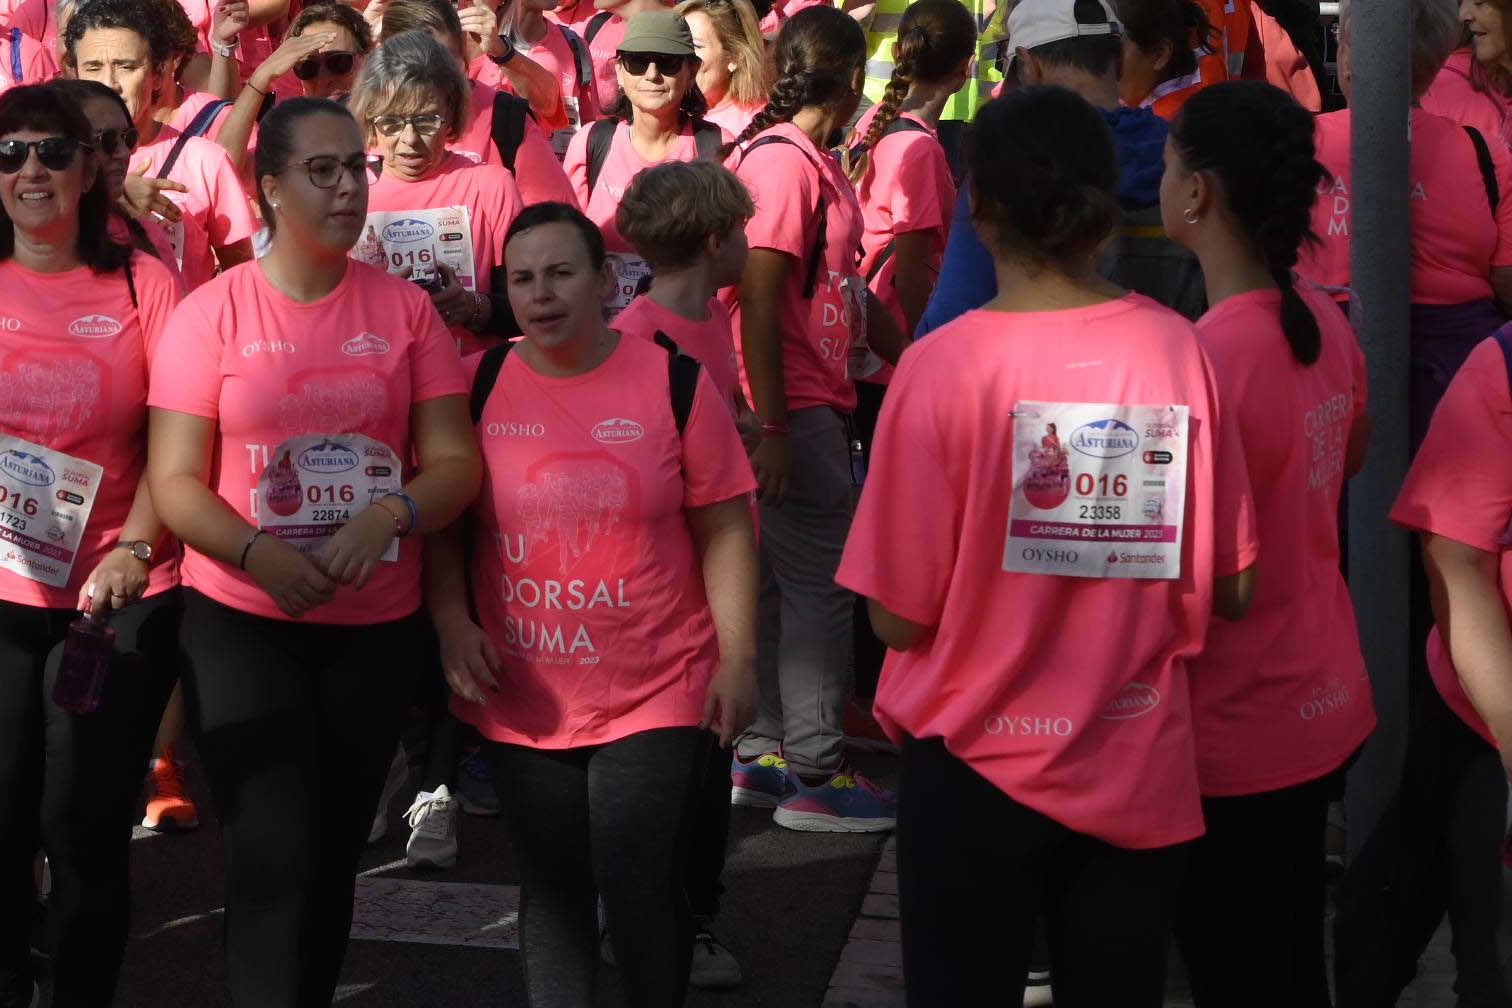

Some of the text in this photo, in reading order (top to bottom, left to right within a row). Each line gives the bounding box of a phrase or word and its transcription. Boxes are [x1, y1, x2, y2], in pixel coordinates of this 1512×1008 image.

[391, 249, 431, 267] 016
[242, 339, 296, 358] OYSHO
[488, 422, 545, 437] OYSHO
[1075, 433, 1134, 449] ASTURIANA
[302, 455, 355, 466] ASTURIANA
[1, 456, 50, 484] ASTURIANA
[1076, 472, 1128, 497] 016
[306, 484, 355, 504] 016
[312, 510, 350, 522] 22874
[1079, 505, 1121, 520] 23358
[2, 530, 13, 539] LA
[1030, 526, 1080, 537] CARRERA
[1082, 528, 1097, 537] DE
[1098, 529, 1109, 538] LA
[1111, 529, 1141, 538] MUJER
[16, 553, 60, 576] Santander
[1022, 548, 1165, 565] OYSHO Santander
[501, 578, 631, 610] DORSAL
[504, 615, 596, 654] SUMA
[985, 714, 1073, 736] OYSHO
